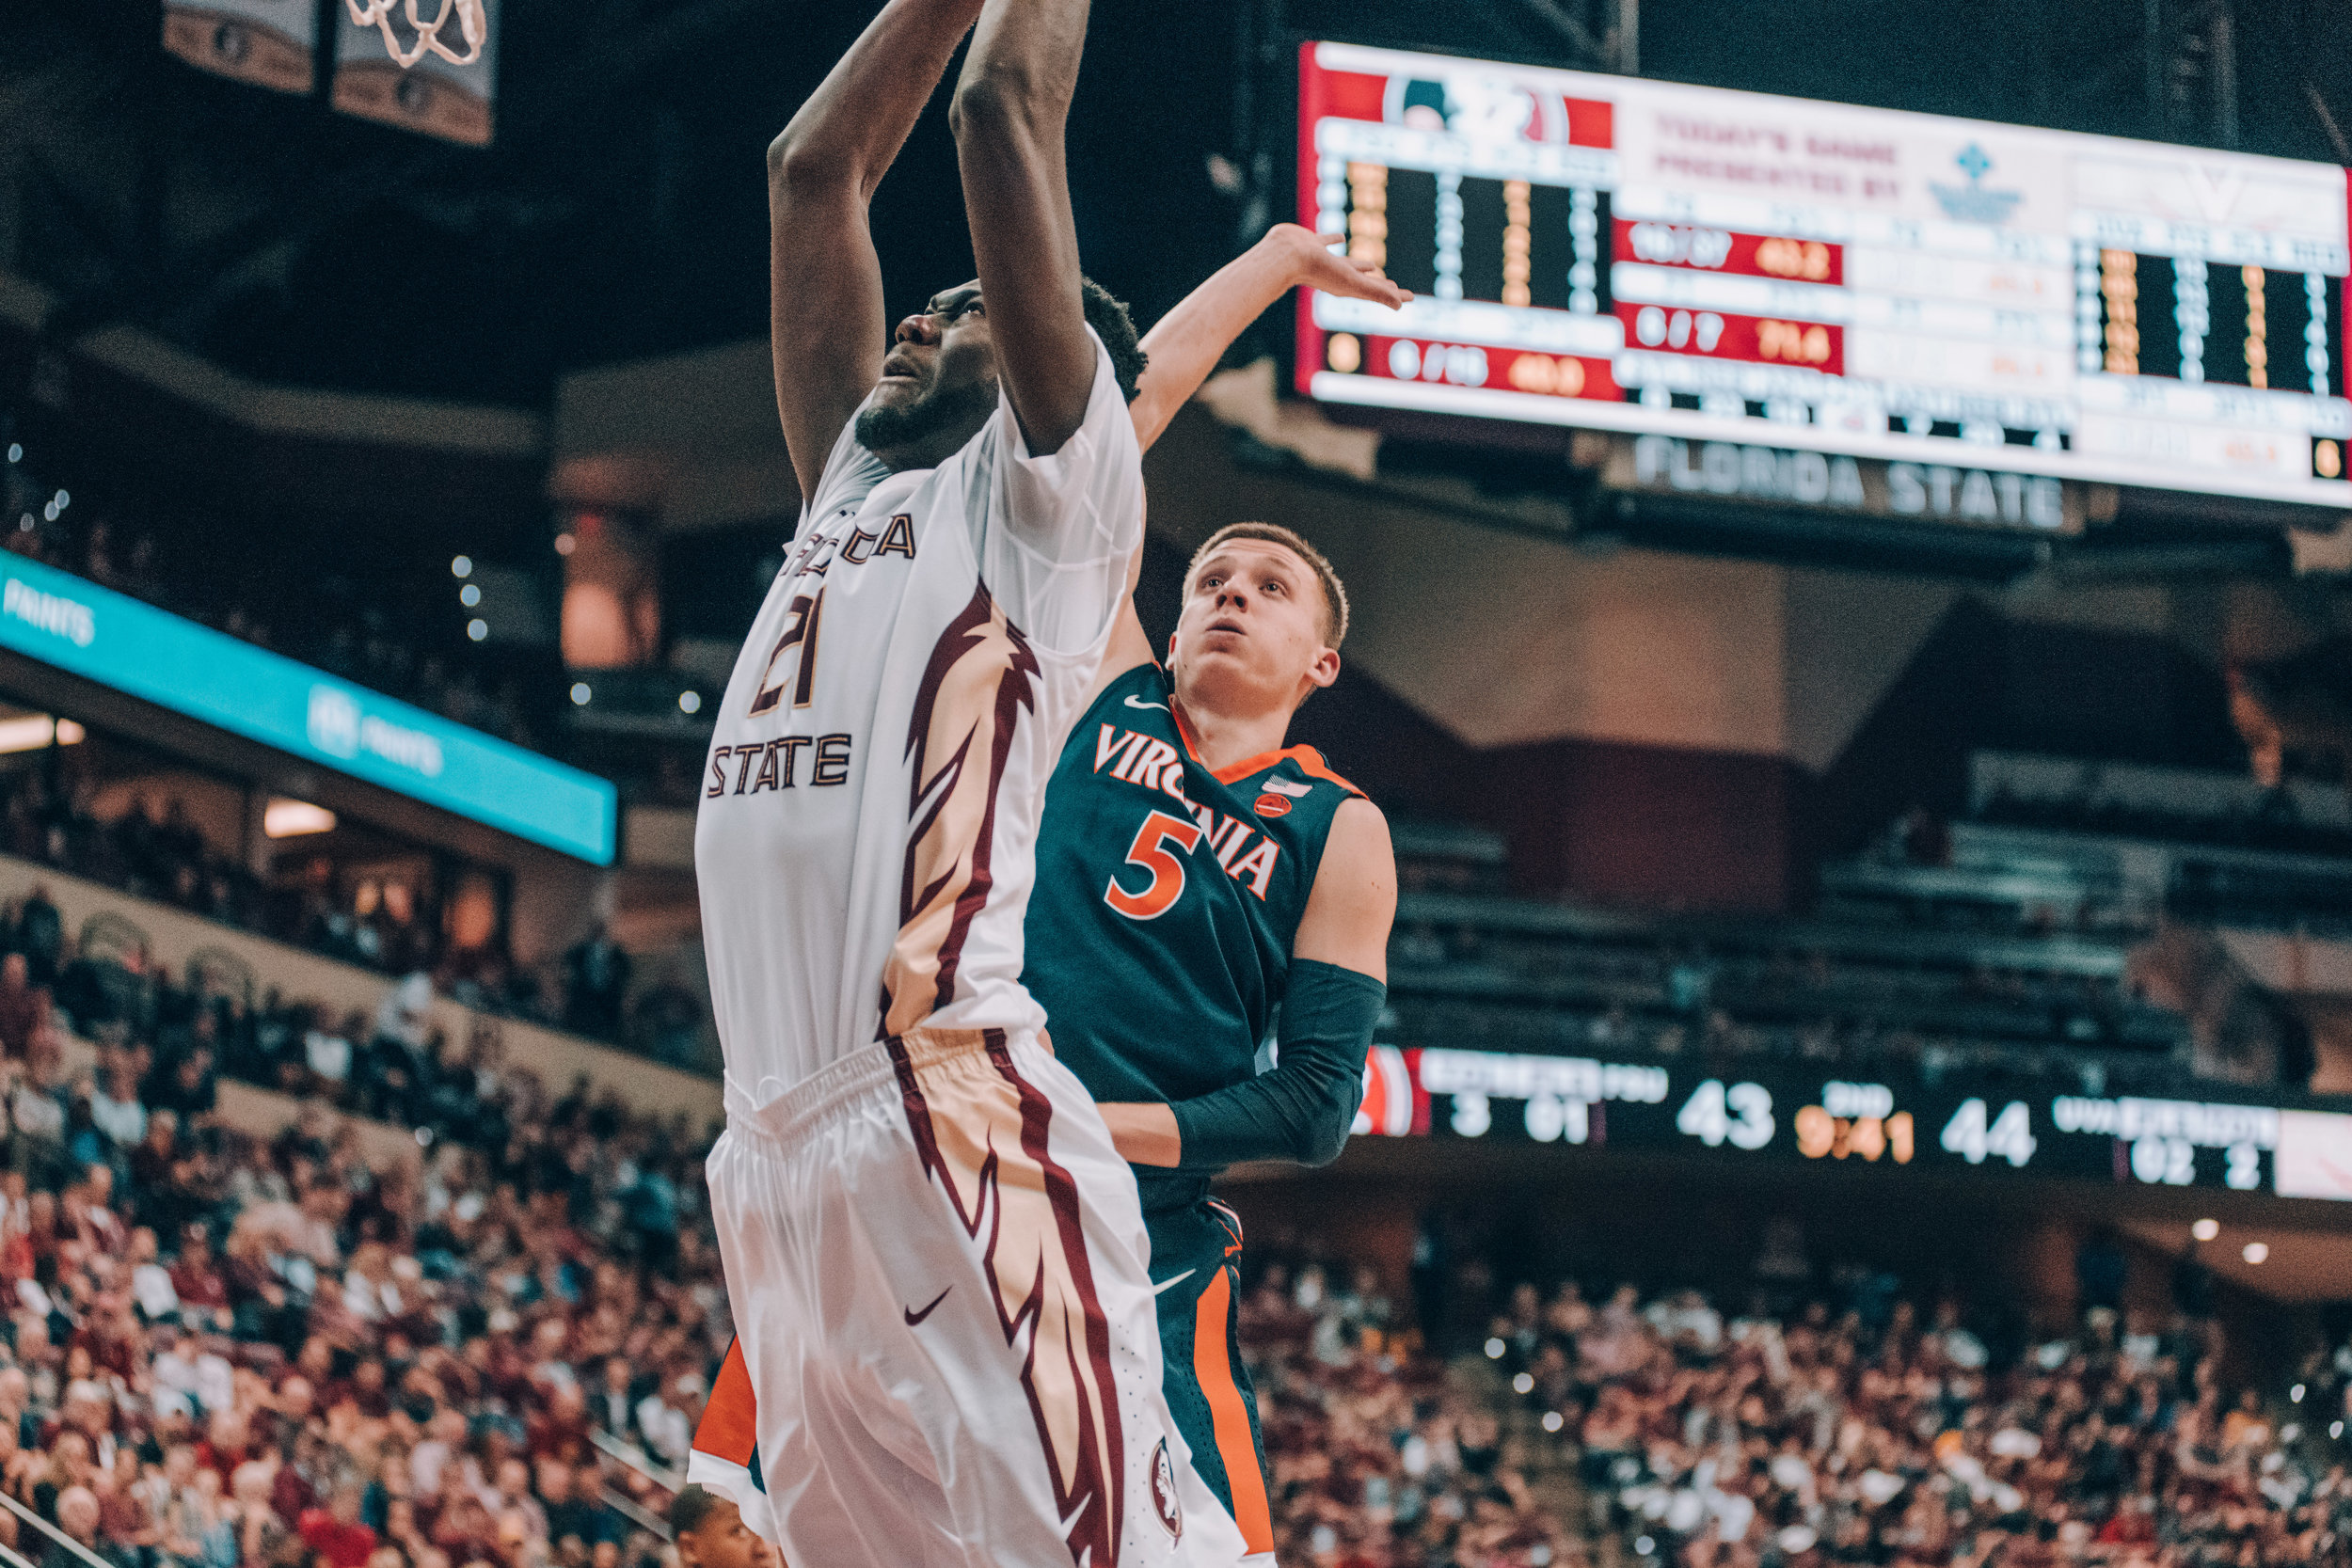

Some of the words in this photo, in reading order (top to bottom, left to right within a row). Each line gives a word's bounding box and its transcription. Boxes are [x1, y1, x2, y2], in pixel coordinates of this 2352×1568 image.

[1635, 435, 1864, 506] FLORIDA
[1888, 461, 2063, 527] STATE
[747, 584, 827, 719] 21
[707, 734, 851, 799] STATE
[1094, 723, 1280, 901] VIRGNIA
[1104, 809, 1204, 921] 5
[1677, 1080, 1776, 1149] 43
[1795, 1104, 1914, 1164] 9:41
[1940, 1098, 2037, 1167] 44
